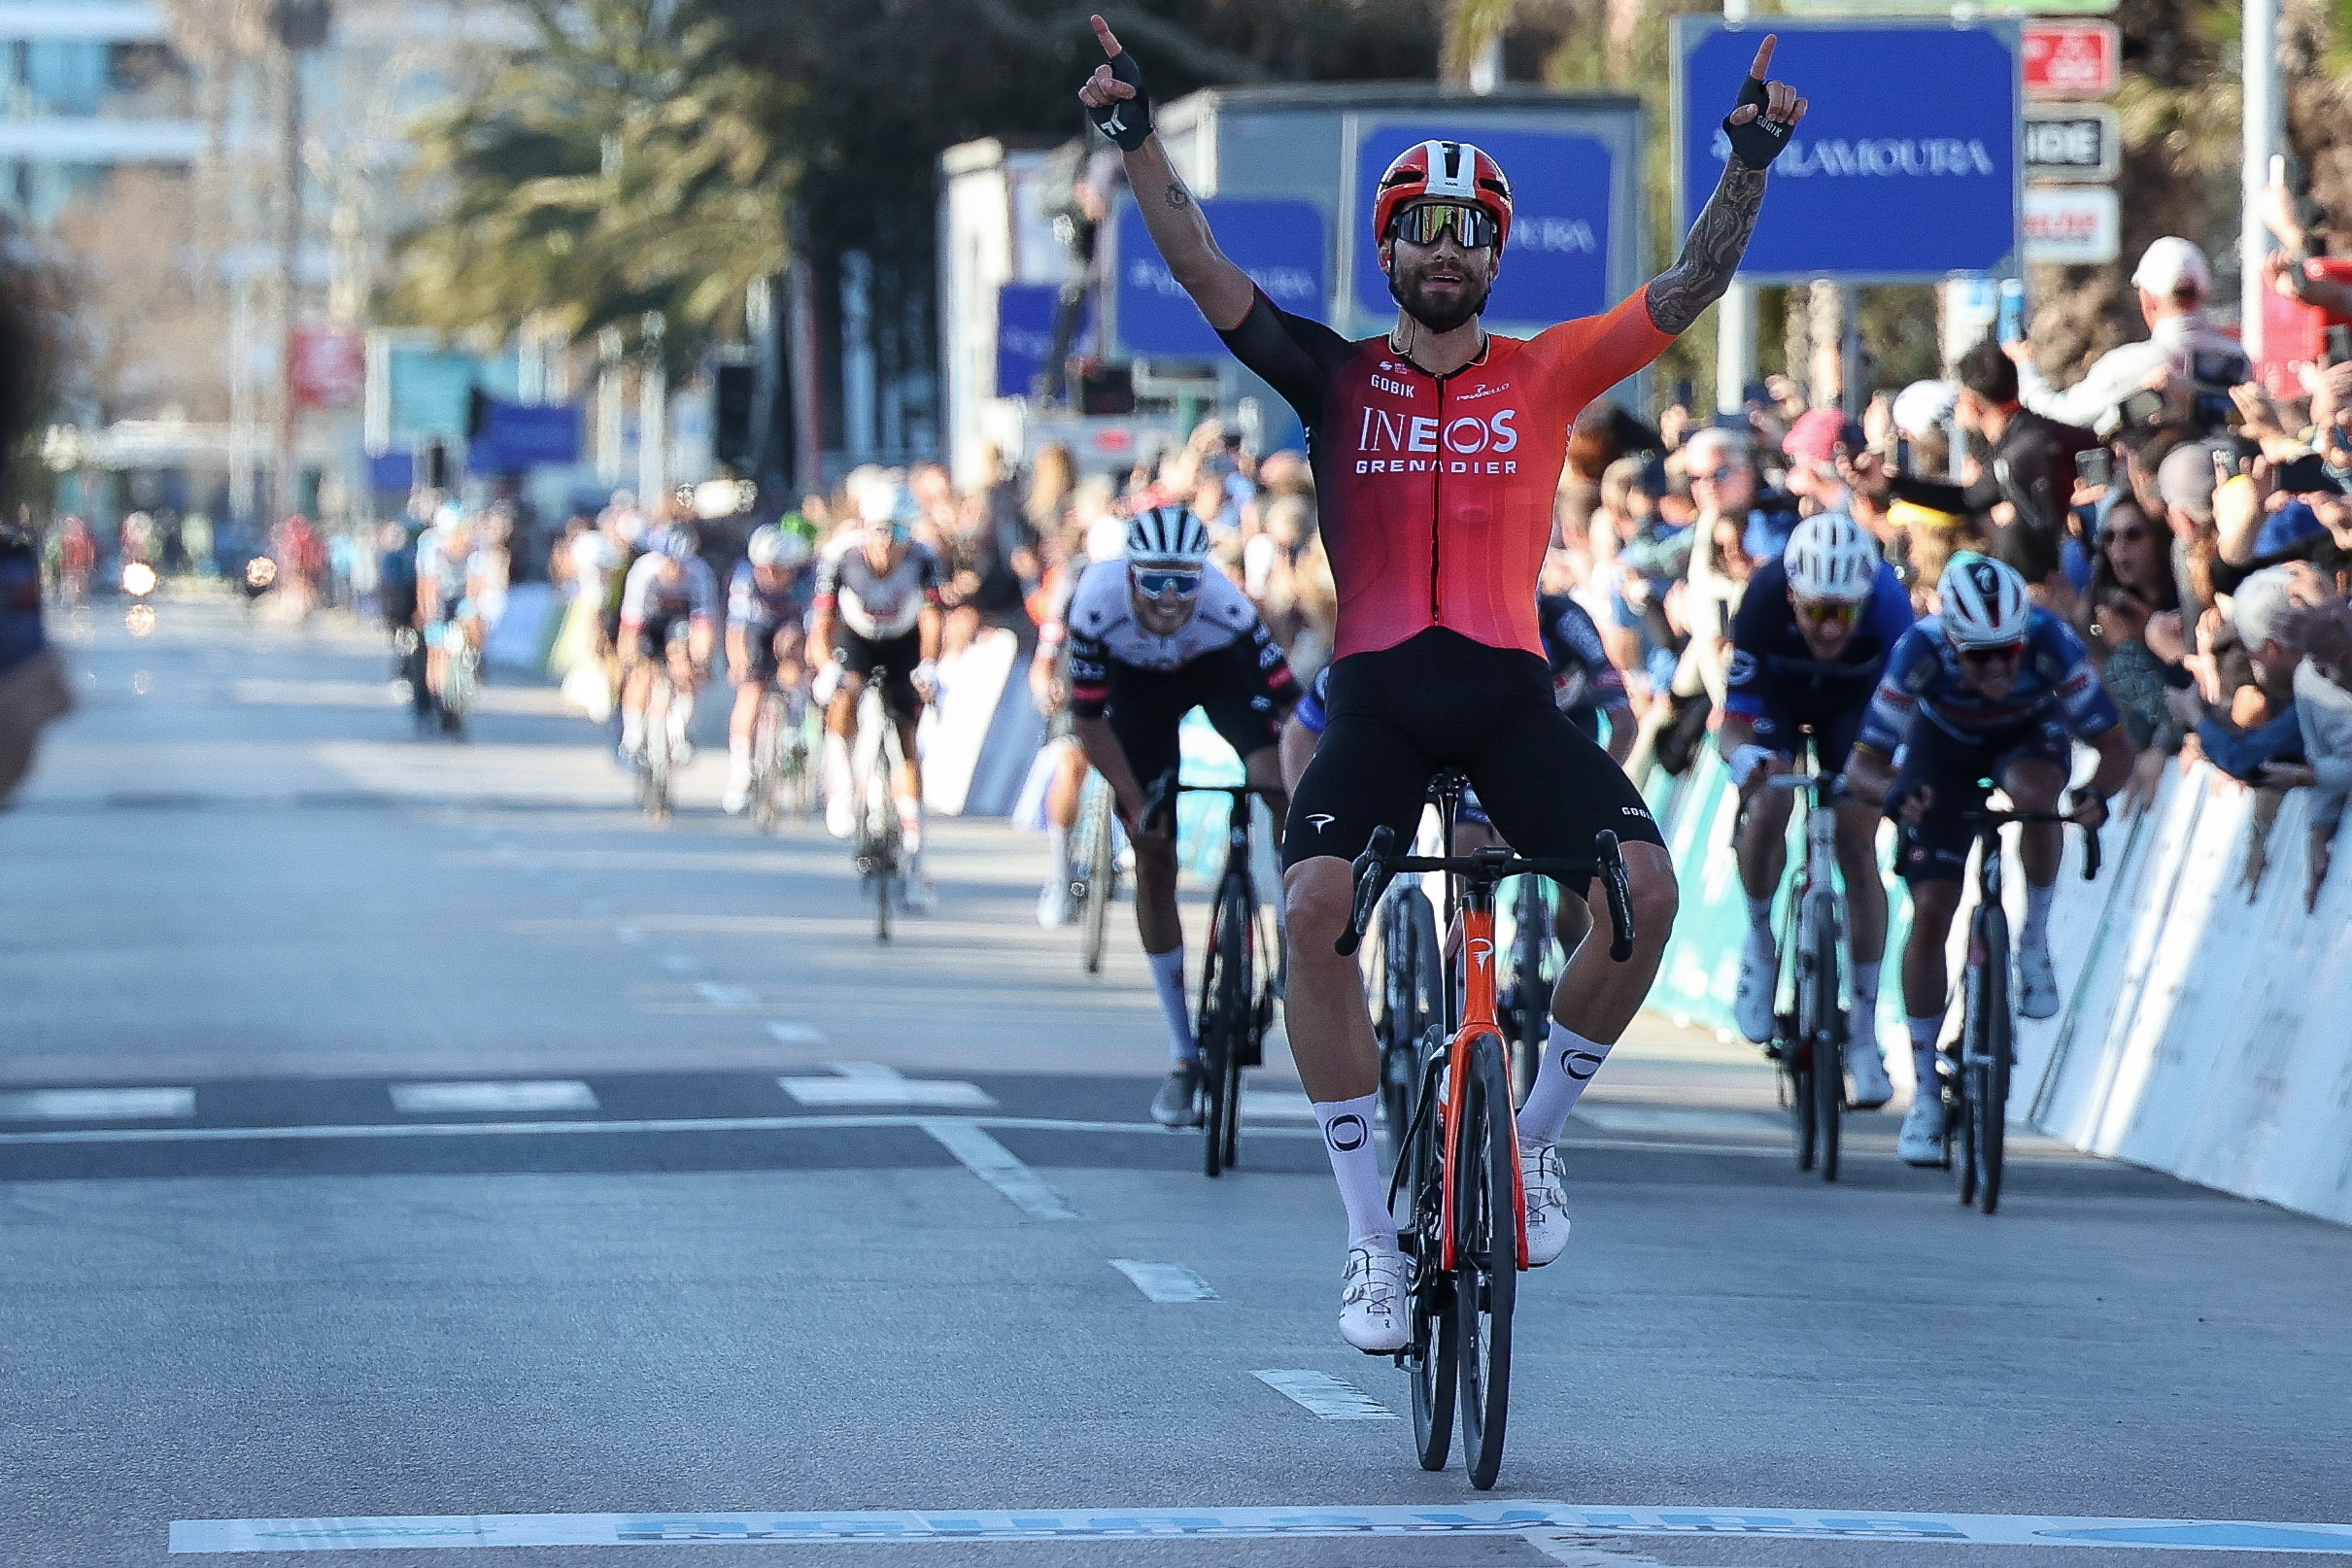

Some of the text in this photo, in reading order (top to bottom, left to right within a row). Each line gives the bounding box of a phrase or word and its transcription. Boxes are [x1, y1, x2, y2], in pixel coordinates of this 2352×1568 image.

[1756, 115, 1783, 138] GOBIK
[1371, 374, 1415, 398] GOBIK
[1357, 406, 1517, 454] INEOS
[1355, 460, 1517, 474] GRENADIER
